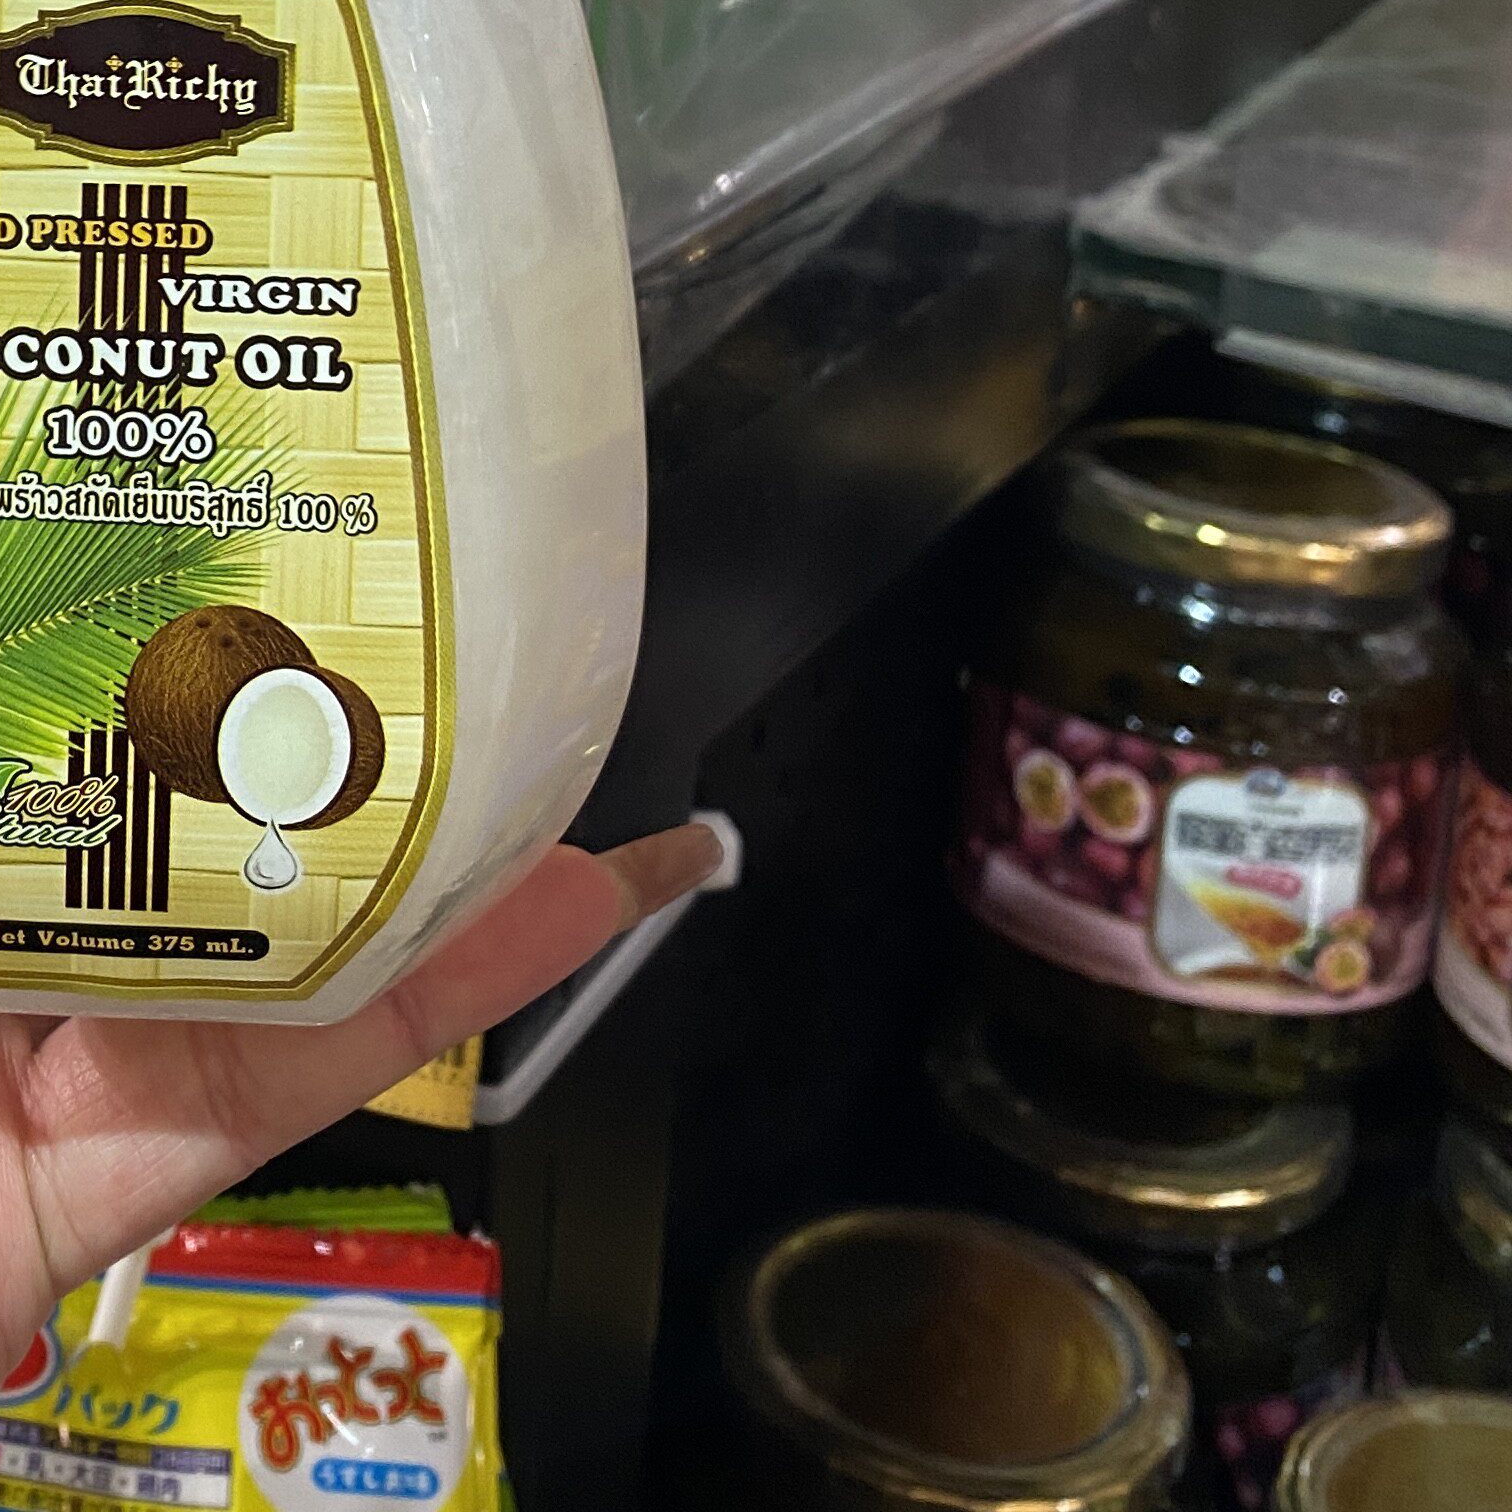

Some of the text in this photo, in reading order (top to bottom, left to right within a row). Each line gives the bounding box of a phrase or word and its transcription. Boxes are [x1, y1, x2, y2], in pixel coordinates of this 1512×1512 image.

[29, 218, 208, 249] PRESSED
[159, 277, 360, 313] VIRGIN
[242, 342, 347, 384] OIL
[46, 409, 216, 461] 100%
[279, 491, 334, 531] 100
[5, 775, 119, 818] 100%
[37, 929, 136, 951] Volume
[147, 934, 195, 952] 375
[205, 937, 255, 955] mL.
[249, 1326, 448, 1474] おっとっと
